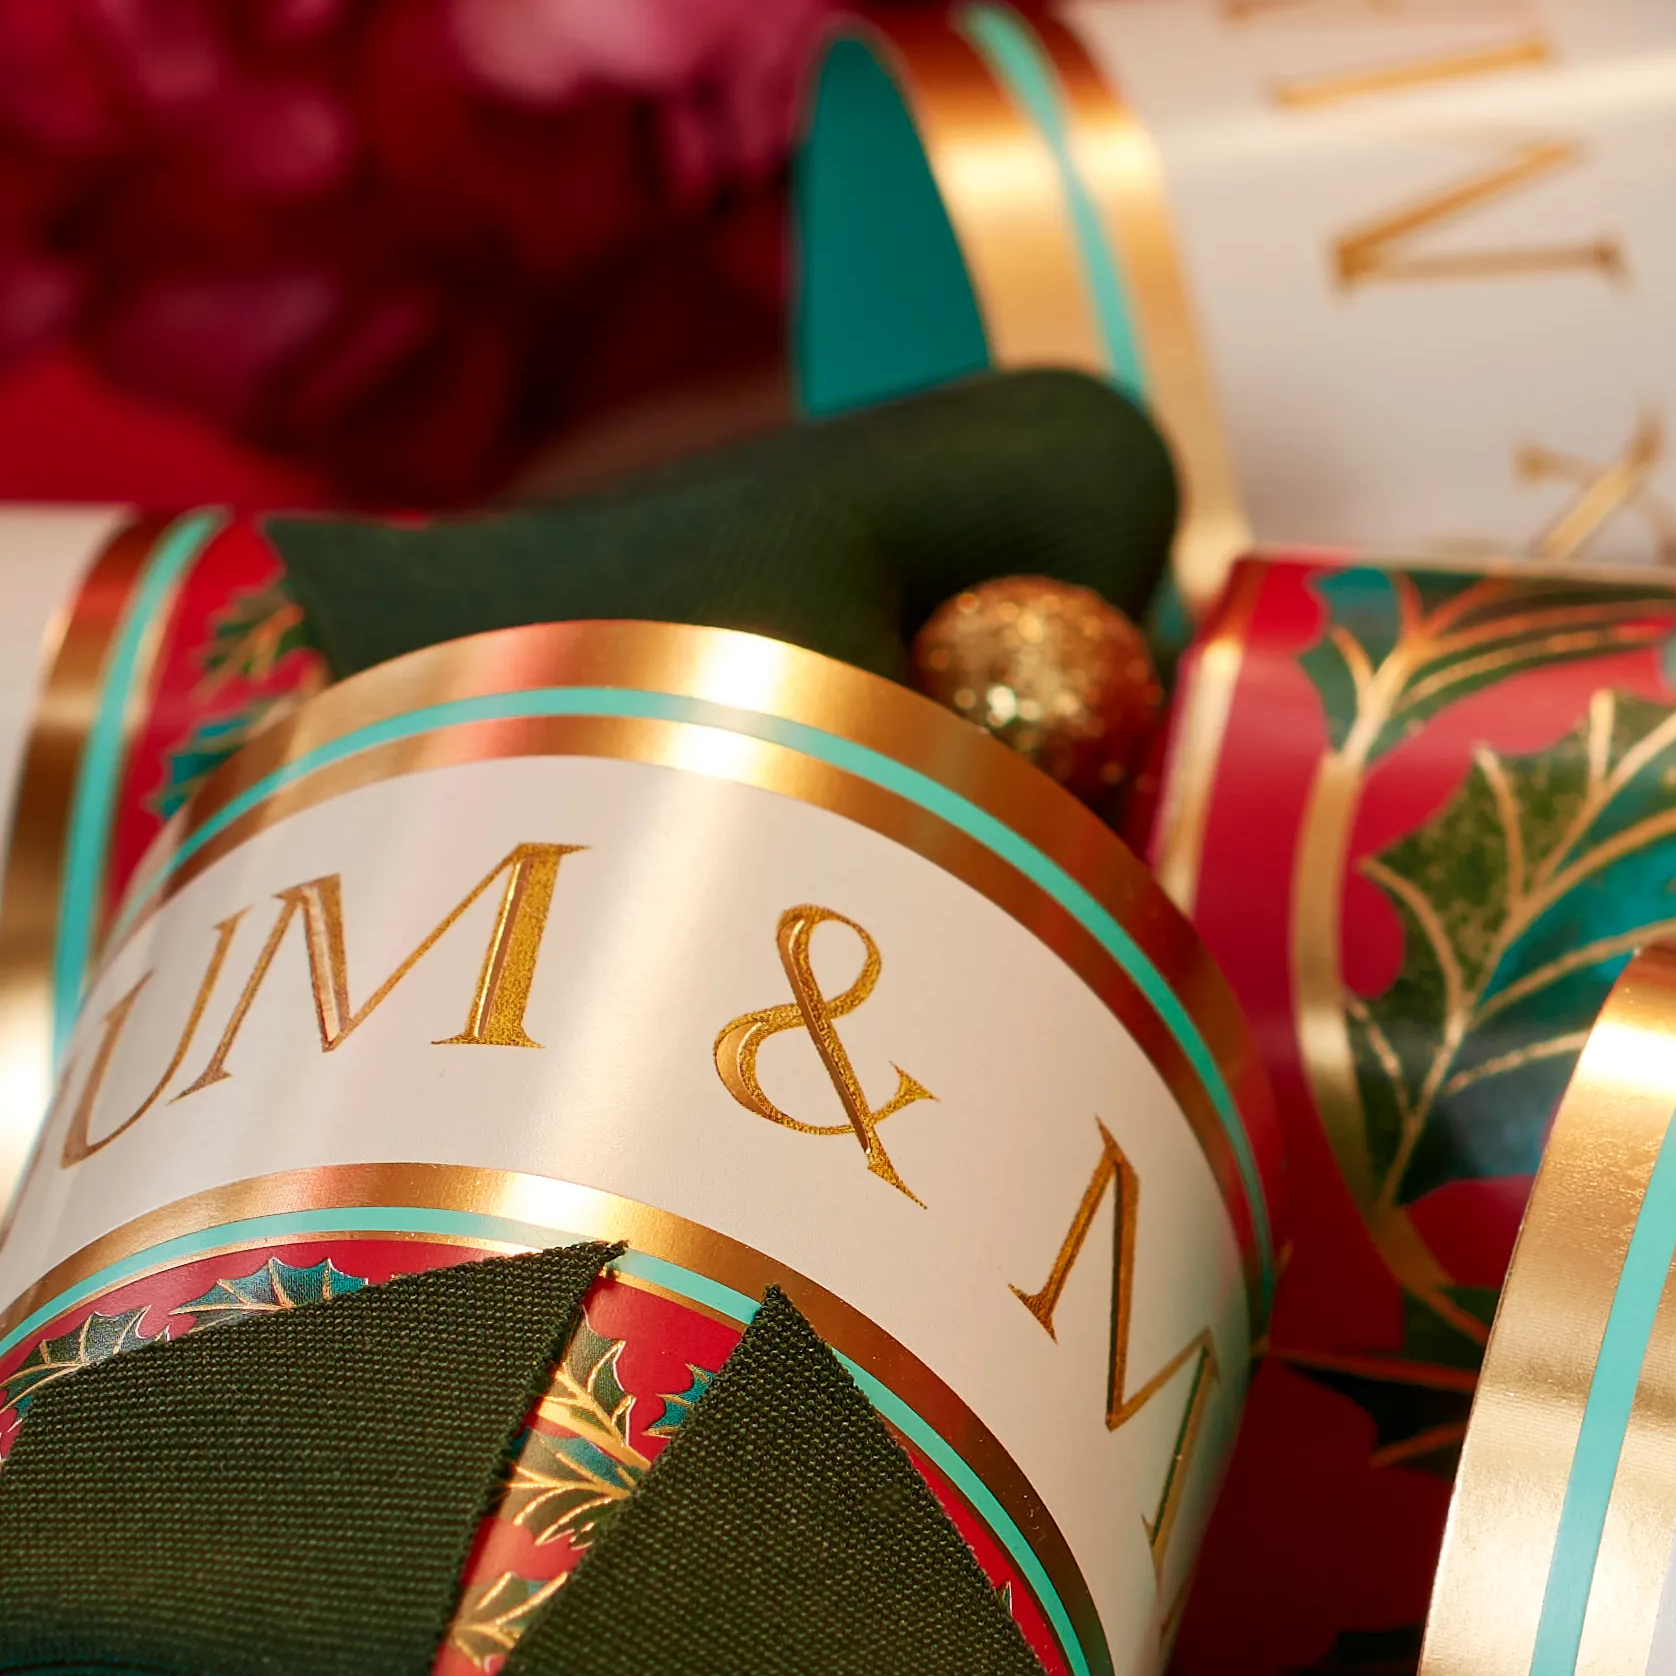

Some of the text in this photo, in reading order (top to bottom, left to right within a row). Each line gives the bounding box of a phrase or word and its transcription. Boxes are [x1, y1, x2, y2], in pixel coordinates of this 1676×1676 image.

[42, 842, 1222, 1649] UM & M
